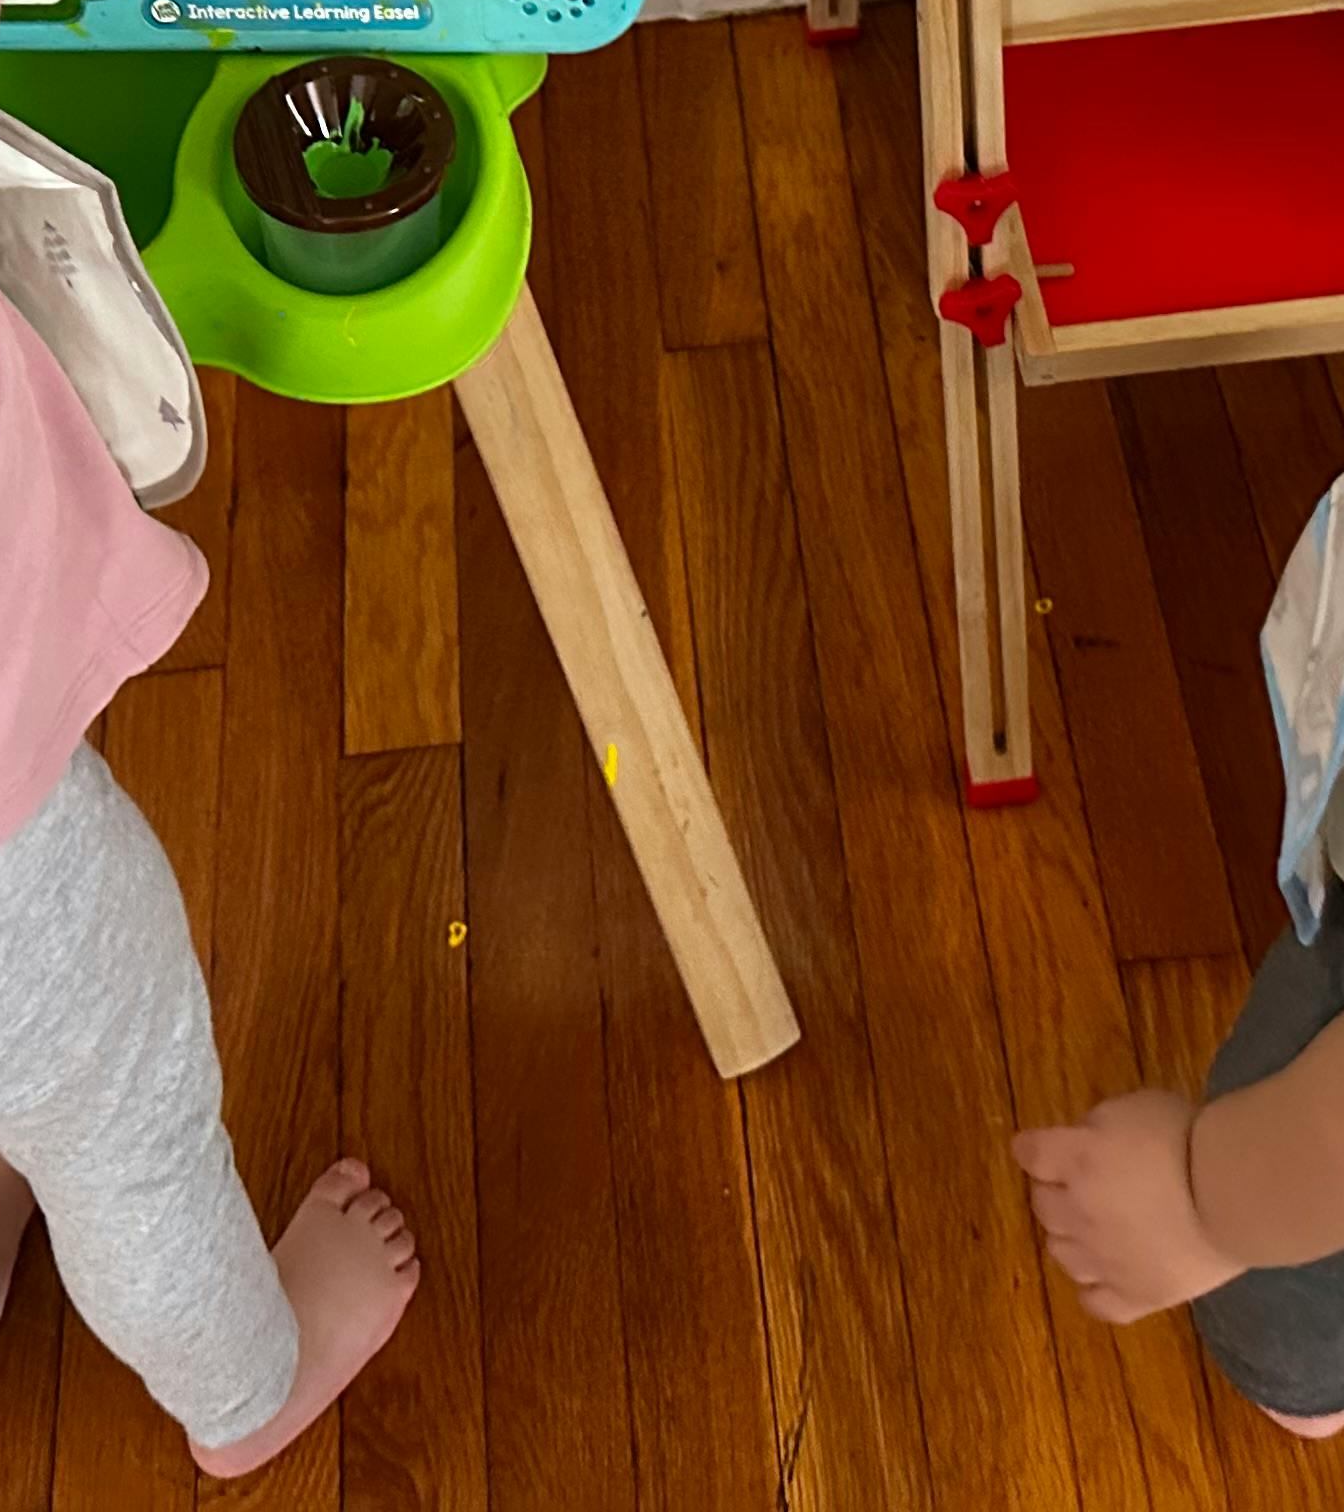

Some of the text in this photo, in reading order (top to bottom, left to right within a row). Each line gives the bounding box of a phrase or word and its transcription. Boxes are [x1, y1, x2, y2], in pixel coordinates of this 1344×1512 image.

[187, 3, 290, 20] Interactive
[293, 4, 370, 23] Learning
[373, 4, 419, 20] Easel
